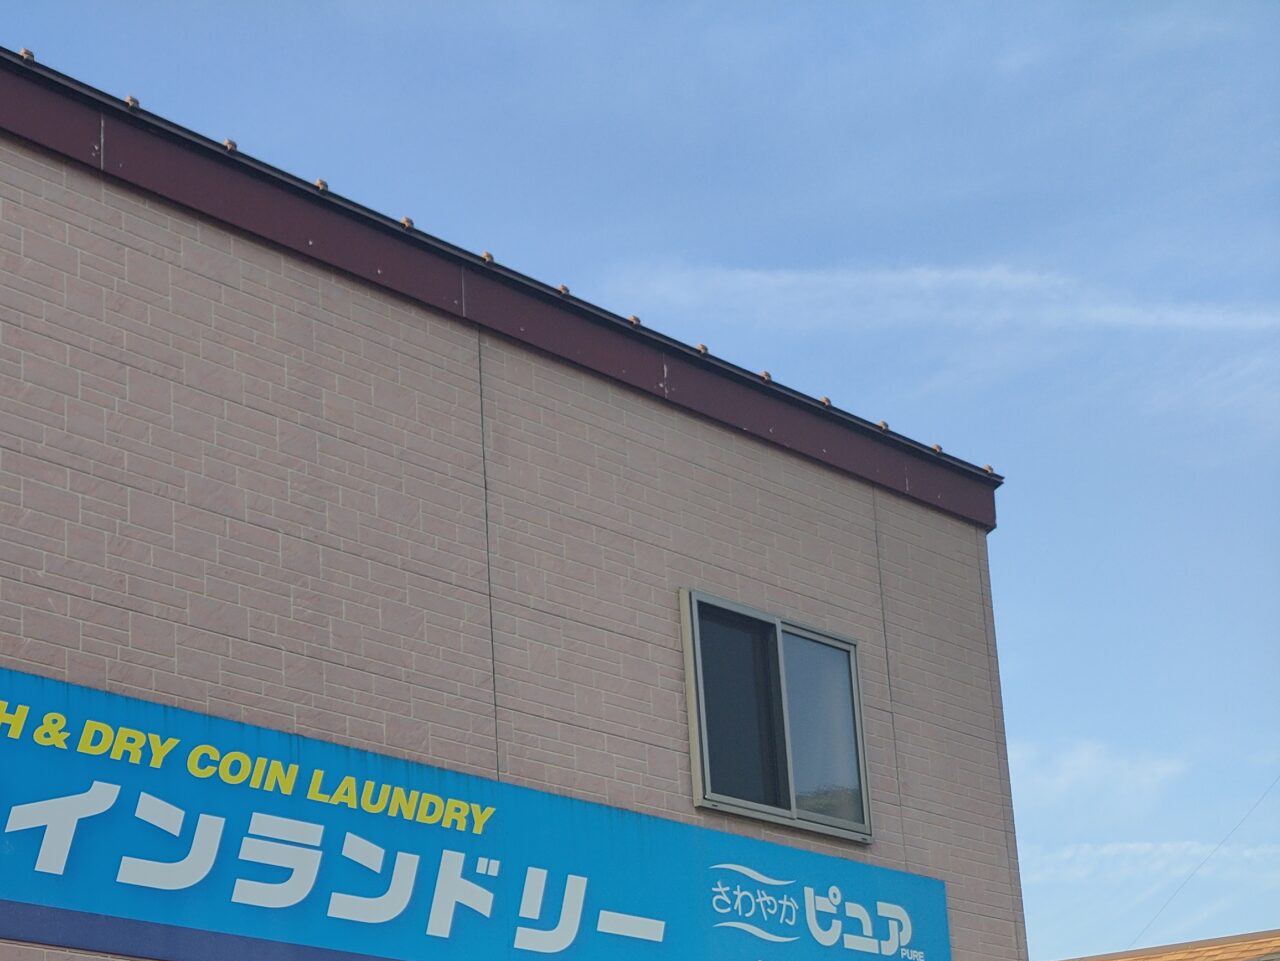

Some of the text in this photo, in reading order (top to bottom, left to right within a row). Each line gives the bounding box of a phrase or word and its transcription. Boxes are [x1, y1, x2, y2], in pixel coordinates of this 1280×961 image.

[33, 712, 68, 750] &
[76, 720, 180, 769] DRY
[186, 744, 299, 796] COIN
[307, 770, 496, 835] LAUNDRY
[711, 881, 799, 926] さわやか
[803, 885, 912, 956] ピュア
